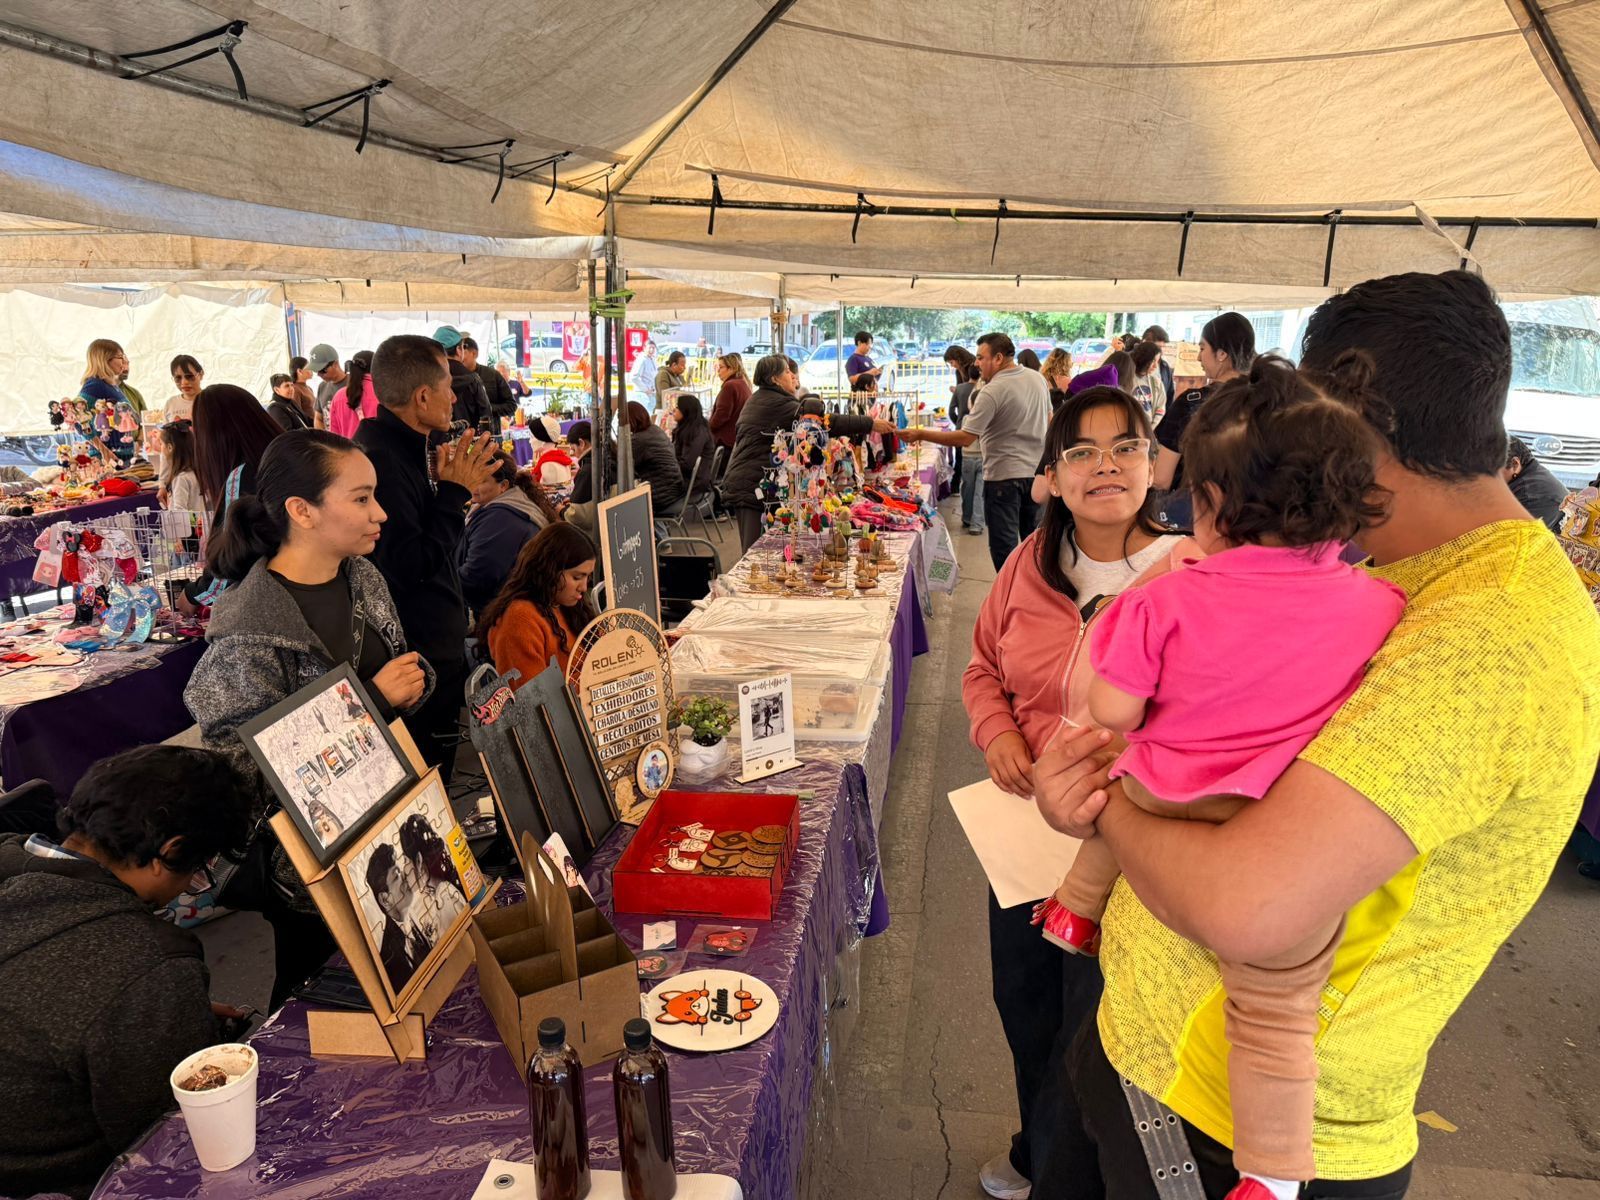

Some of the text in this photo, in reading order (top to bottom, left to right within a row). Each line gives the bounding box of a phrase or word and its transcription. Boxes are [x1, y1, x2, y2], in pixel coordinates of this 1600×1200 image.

[592, 649, 634, 671] ROLEN
[592, 684, 616, 700] DETALLES
[595, 685, 655, 714] EXHIBIDORES
[597, 699, 659, 730] CHAROLA DESAYUNO
[603, 715, 657, 743] RECUERDITOS
[600, 740, 630, 759] CENTROS
[632, 737, 641, 747] DE
[643, 729, 660, 742] MESA
[295, 724, 376, 797] EVELYN
